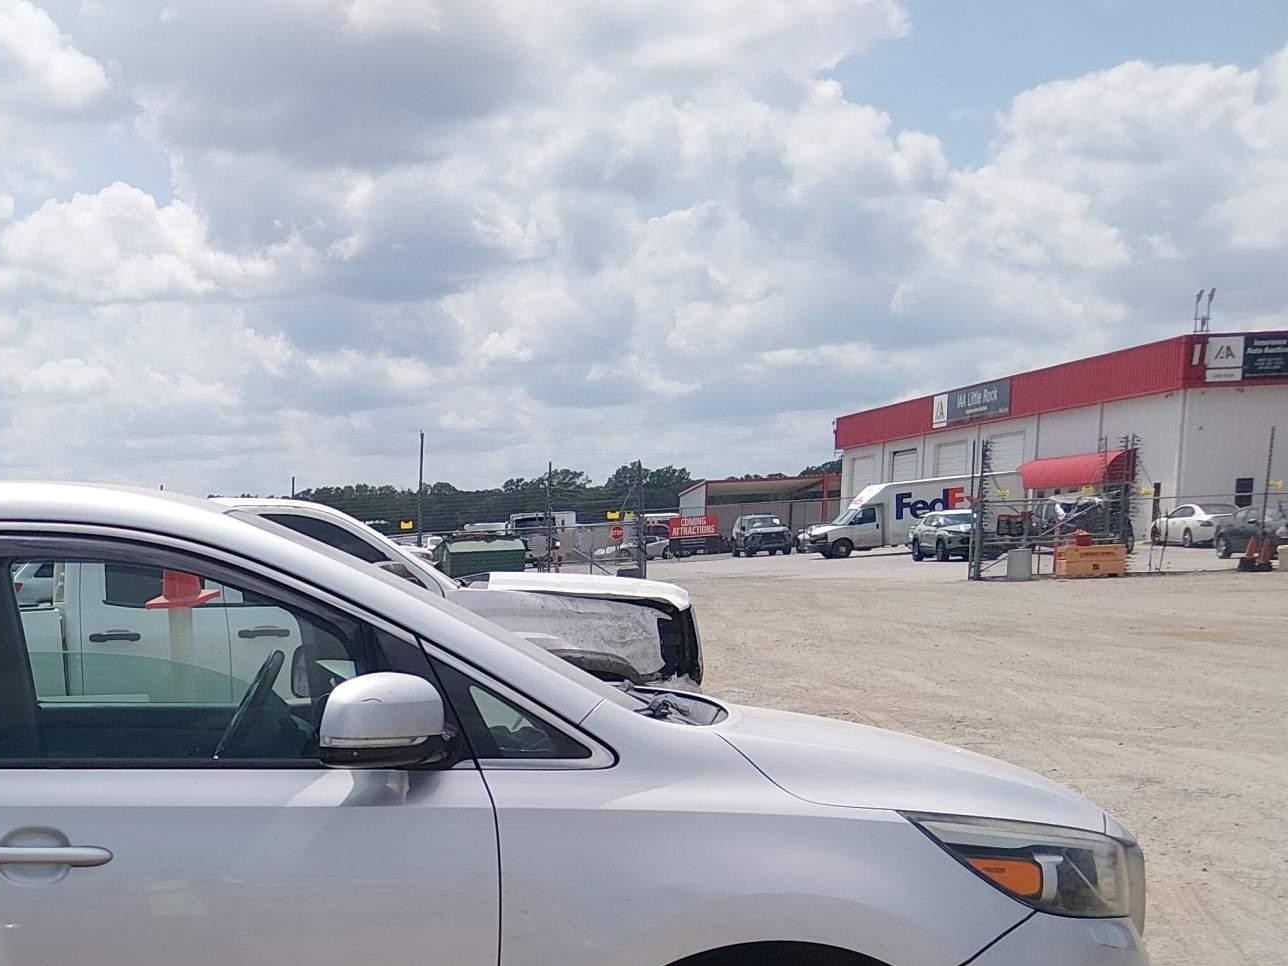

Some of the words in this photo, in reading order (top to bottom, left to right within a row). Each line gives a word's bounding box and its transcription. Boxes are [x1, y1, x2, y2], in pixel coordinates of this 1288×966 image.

[967, 390, 982, 407] Little
[982, 386, 998, 403] Rock
[681, 517, 707, 526] COMING
[672, 525, 715, 536] ATTRACTIONS
